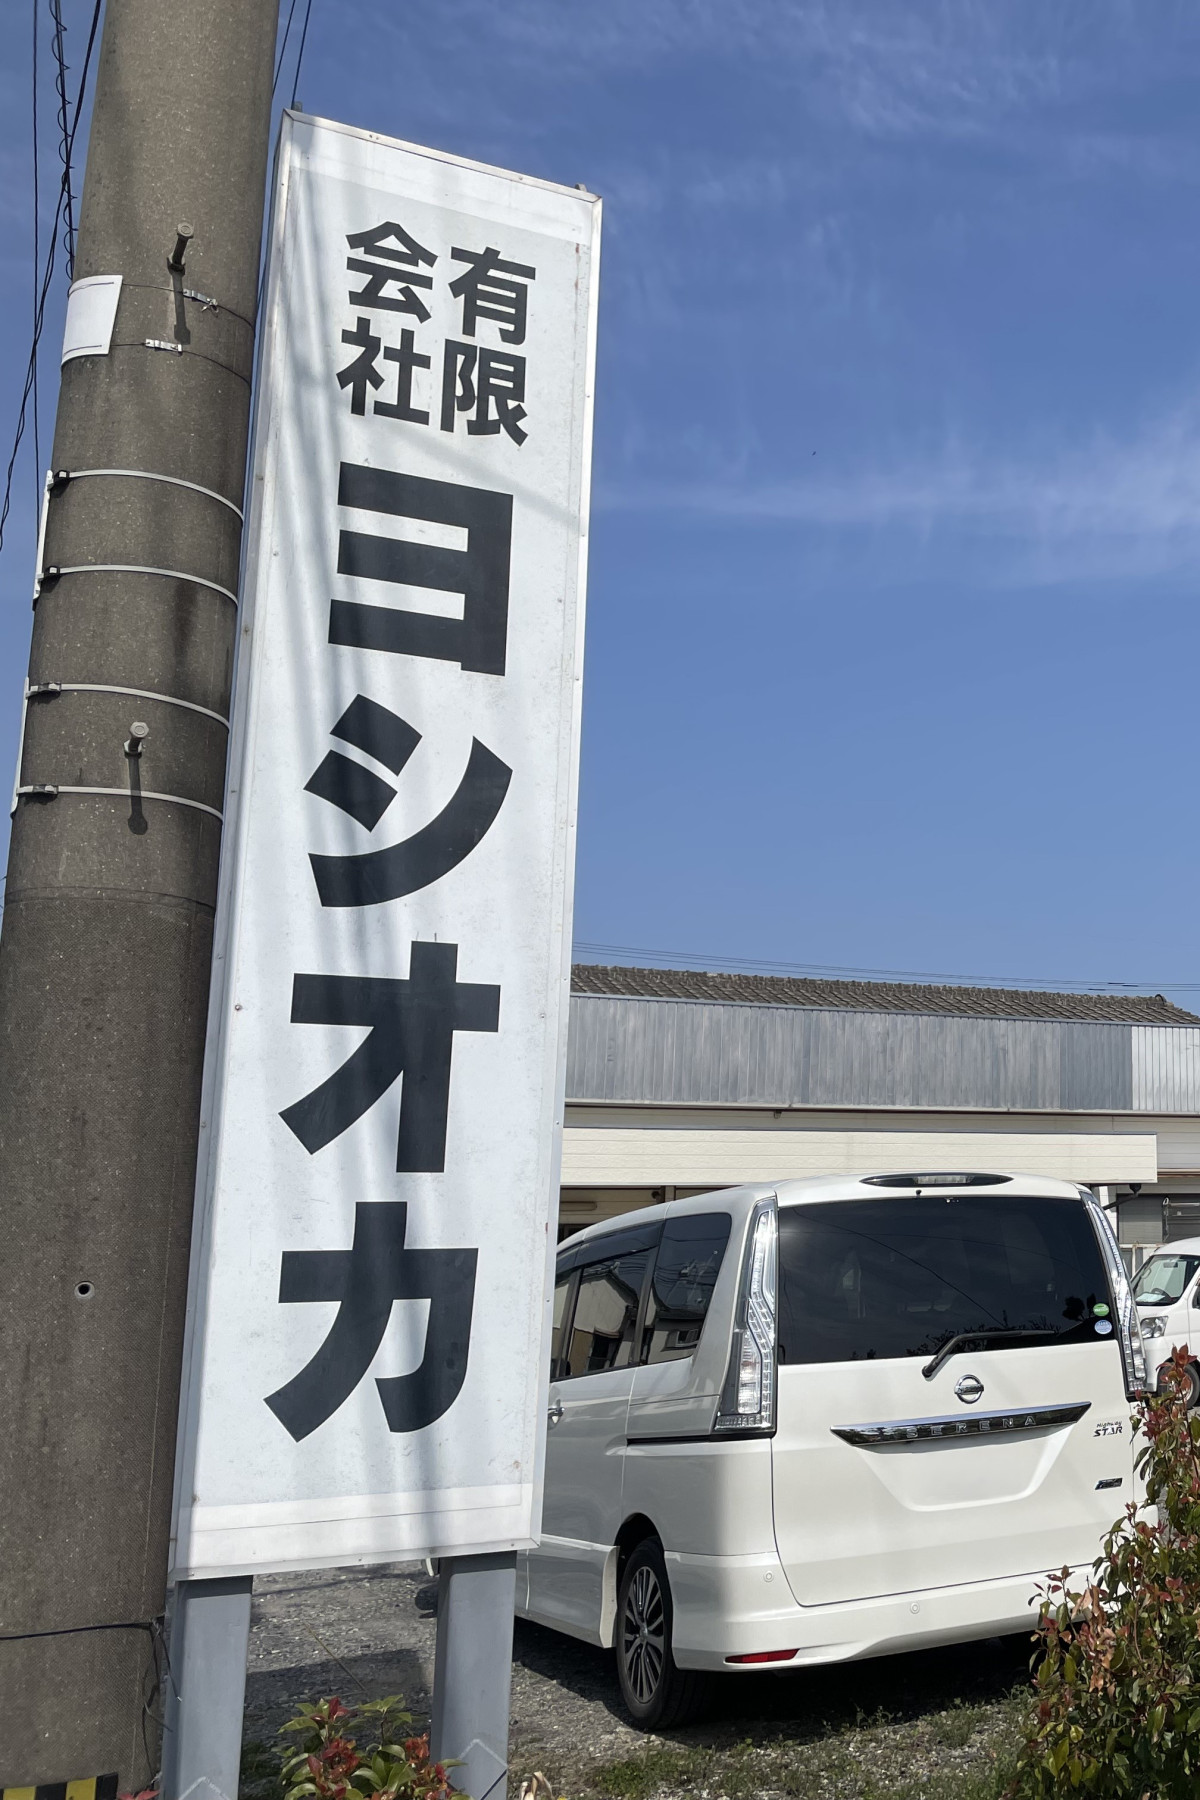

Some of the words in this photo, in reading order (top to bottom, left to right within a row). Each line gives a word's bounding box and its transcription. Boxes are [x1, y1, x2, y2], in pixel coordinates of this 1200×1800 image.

[336, 222, 437, 425] 会社
[441, 247, 536, 446] 有限
[264, 462, 513, 1442] ヨシオカ
[906, 1416, 1036, 1438] SERENA
[1093, 1426, 1123, 1438] STAR
